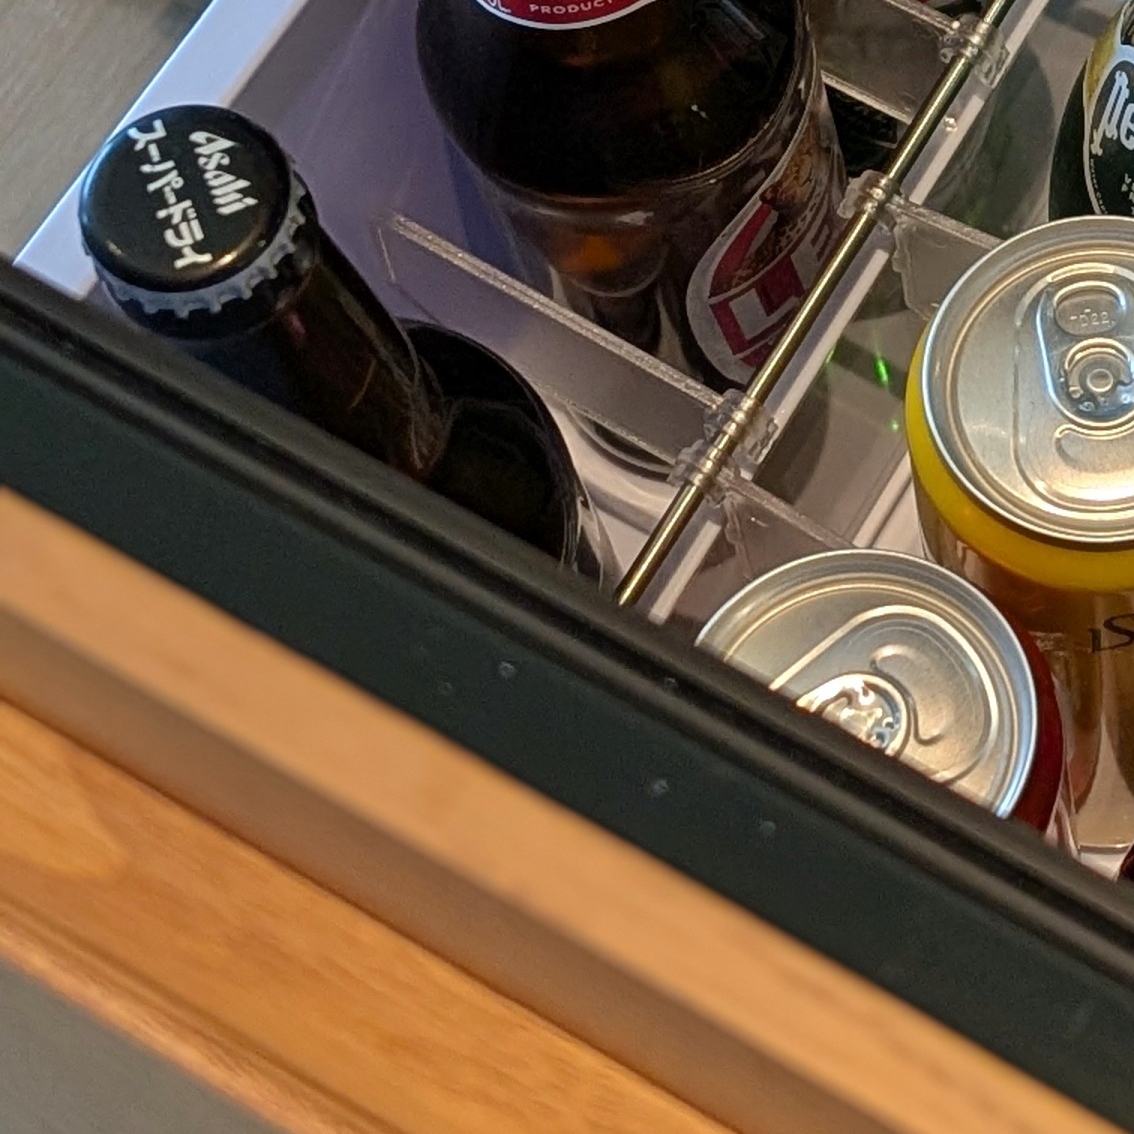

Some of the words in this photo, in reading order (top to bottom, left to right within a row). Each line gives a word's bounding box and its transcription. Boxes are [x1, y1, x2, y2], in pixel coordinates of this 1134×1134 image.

[127, 118, 213, 270] スーパードライ
[188, 130, 258, 216] Asahi
